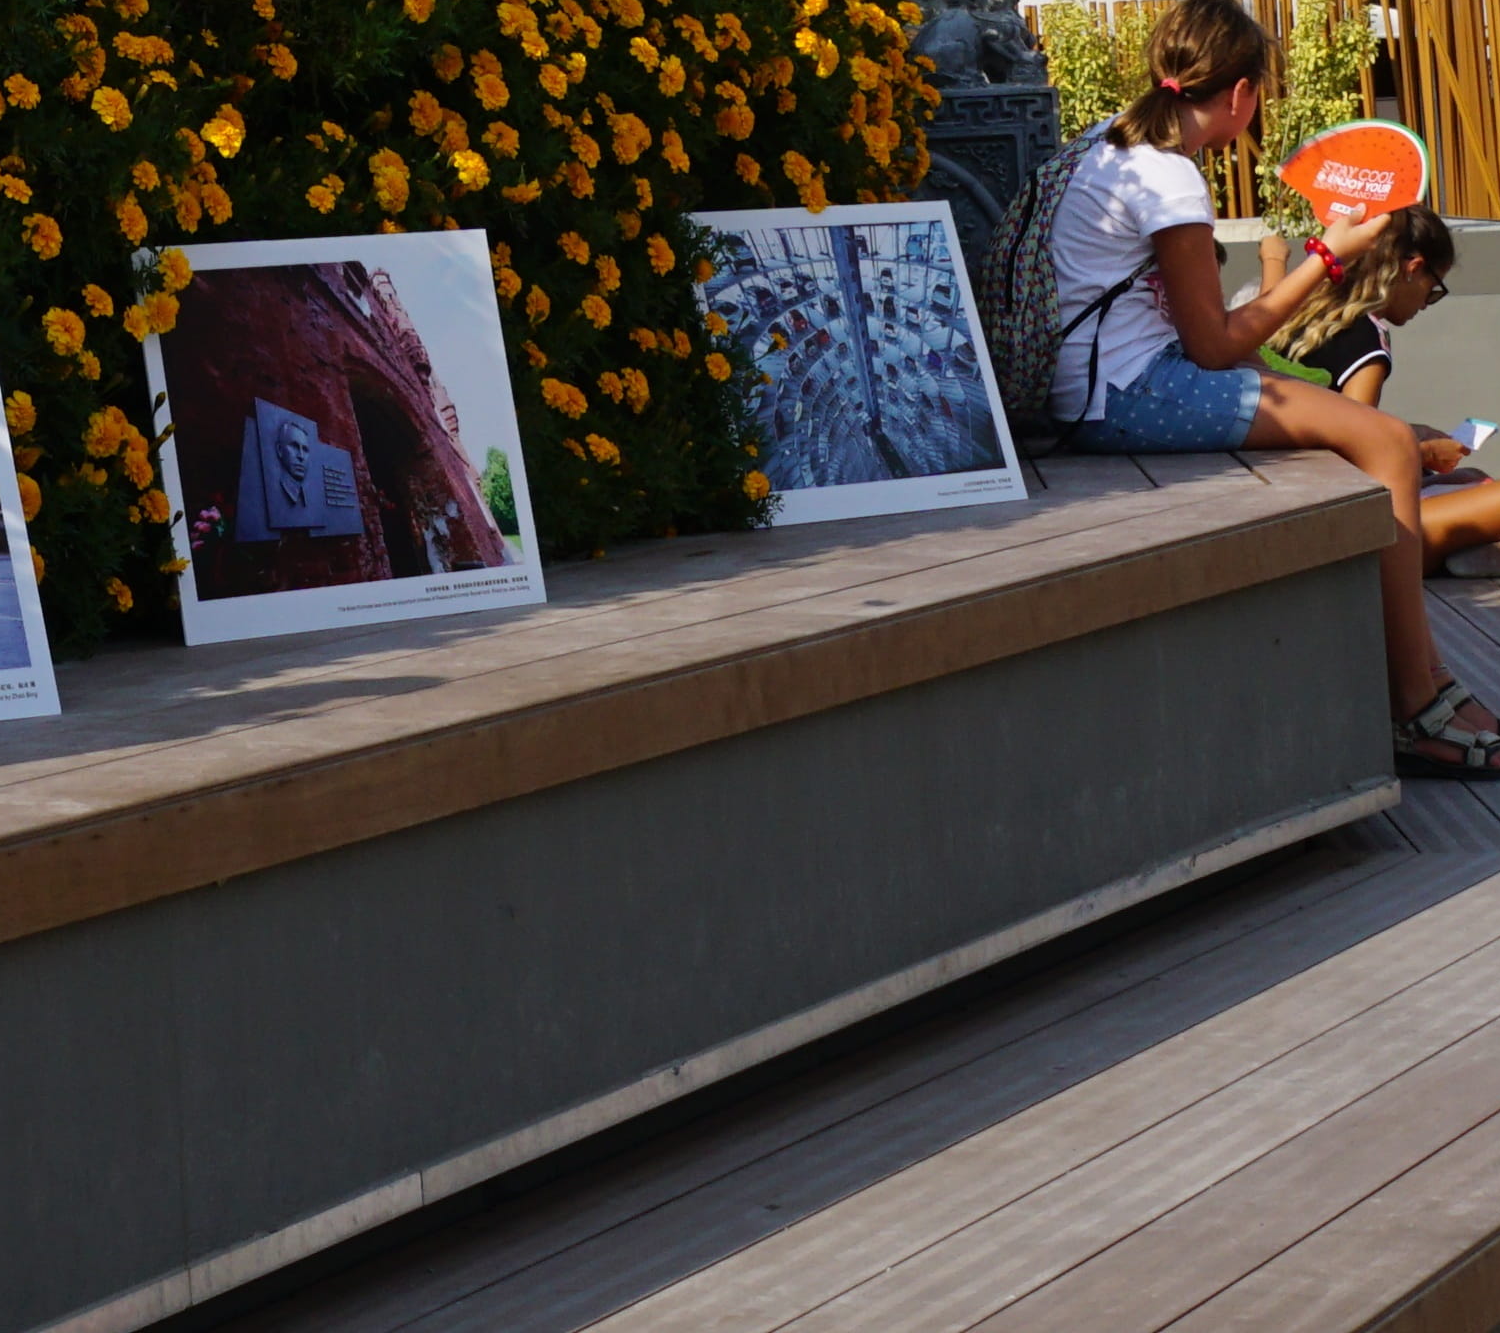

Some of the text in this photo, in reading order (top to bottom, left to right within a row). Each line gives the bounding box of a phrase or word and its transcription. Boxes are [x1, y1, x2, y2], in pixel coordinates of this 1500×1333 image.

[1322, 159, 1395, 184] STAY COOL
[1327, 174, 1364, 190] ENJOY
[1365, 181, 1391, 193] YOUR
